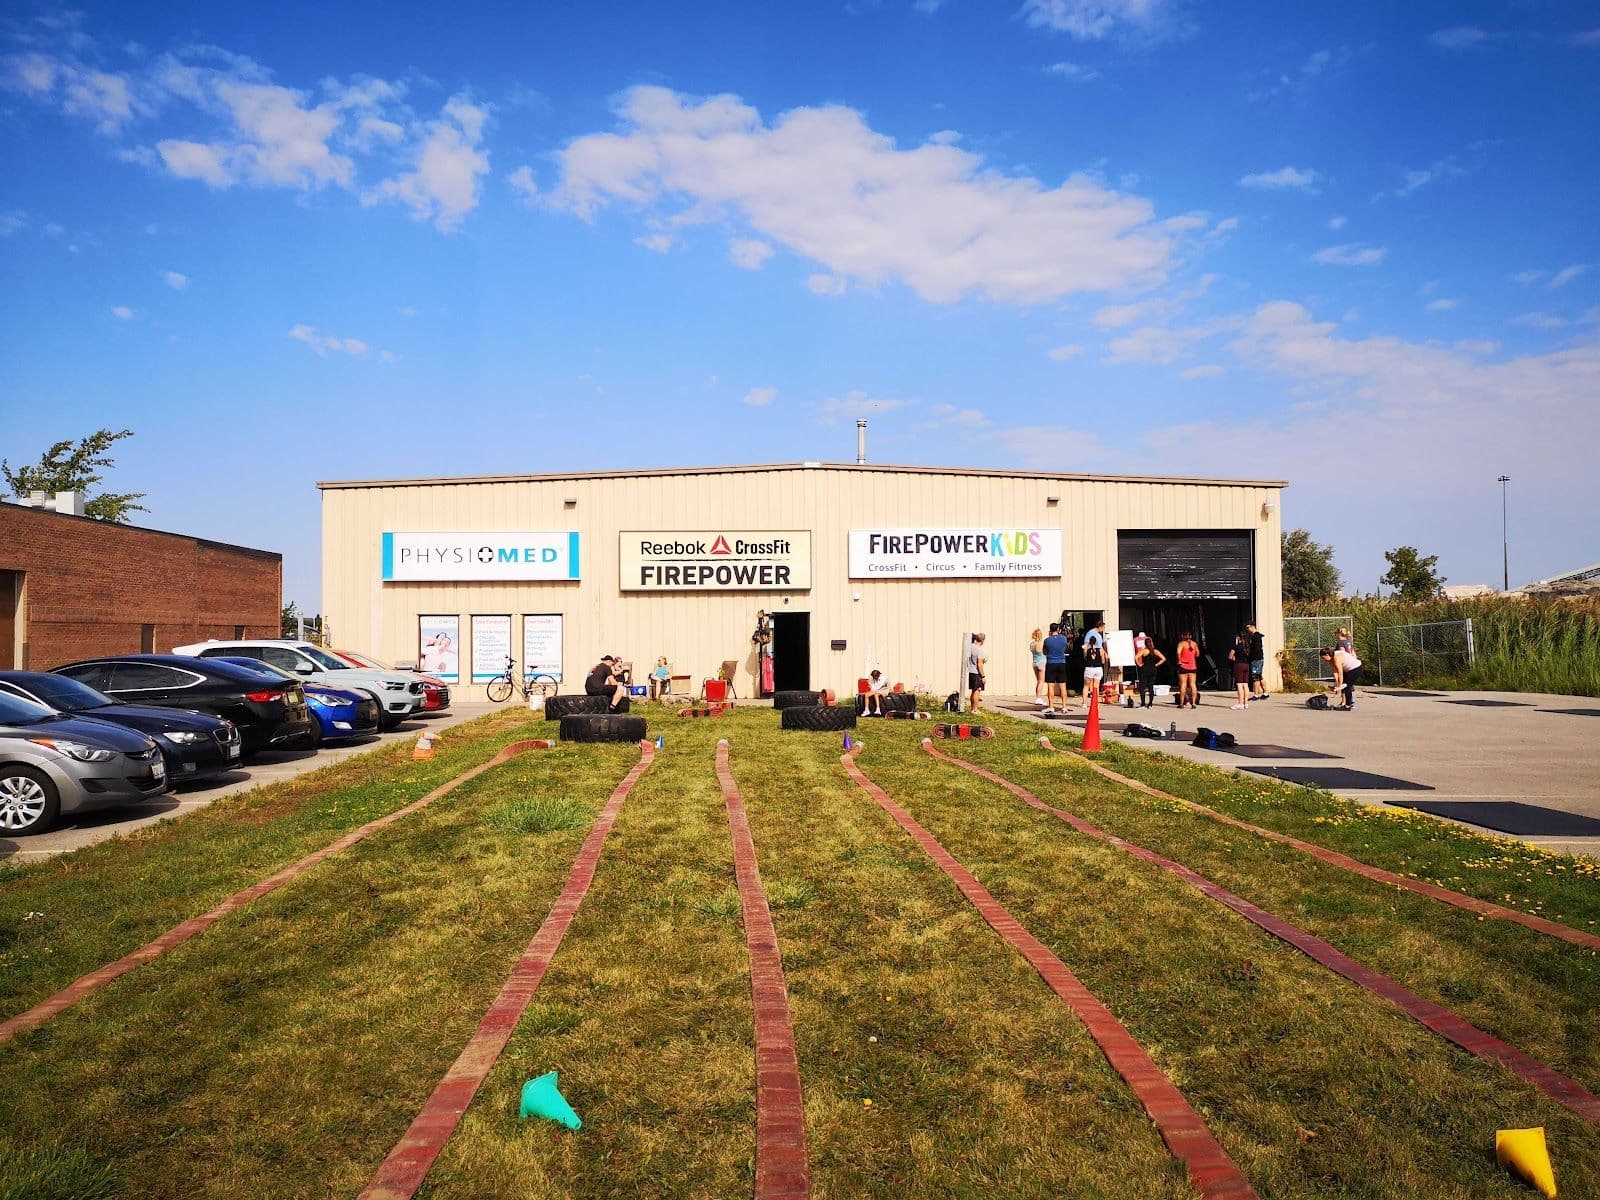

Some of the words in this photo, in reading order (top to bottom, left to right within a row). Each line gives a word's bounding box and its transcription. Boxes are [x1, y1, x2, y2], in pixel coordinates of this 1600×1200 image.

[641, 540, 706, 555] Reebok
[735, 539, 791, 555] CrossFit
[640, 565, 791, 586] FIREPOWER
[868, 563, 907, 572] CrossFit
[926, 562, 955, 572] Circus
[974, 562, 1006, 573] Family
[1008, 562, 1042, 571] Fitness
